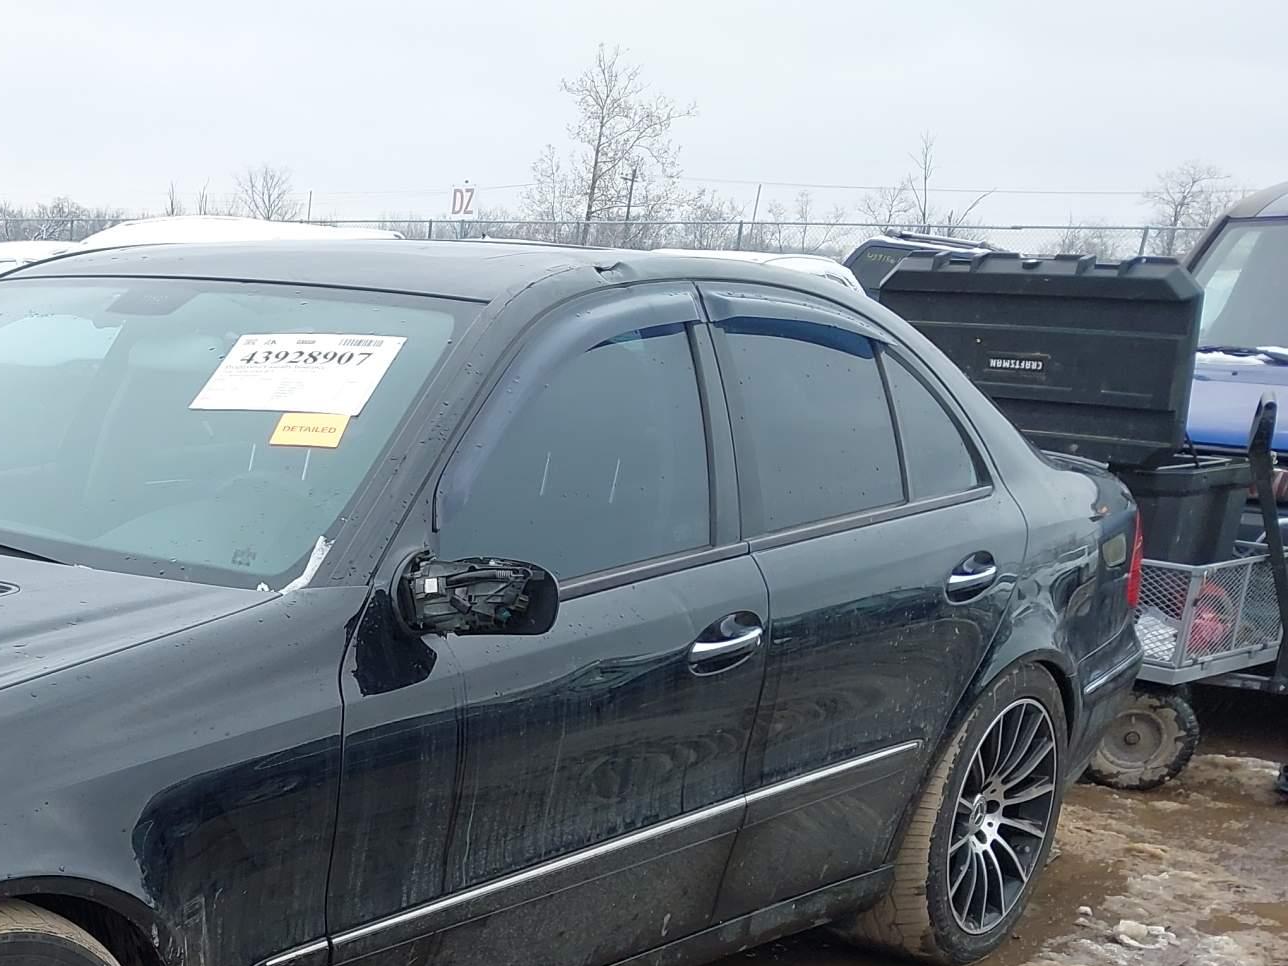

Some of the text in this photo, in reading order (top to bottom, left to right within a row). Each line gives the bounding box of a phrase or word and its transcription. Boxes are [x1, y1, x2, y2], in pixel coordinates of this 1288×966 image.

[451, 188, 475, 215] DZ
[240, 350, 373, 366] 43928907
[989, 358, 1043, 370] CRAFTSMAN
[282, 425, 337, 435] DETAILED
